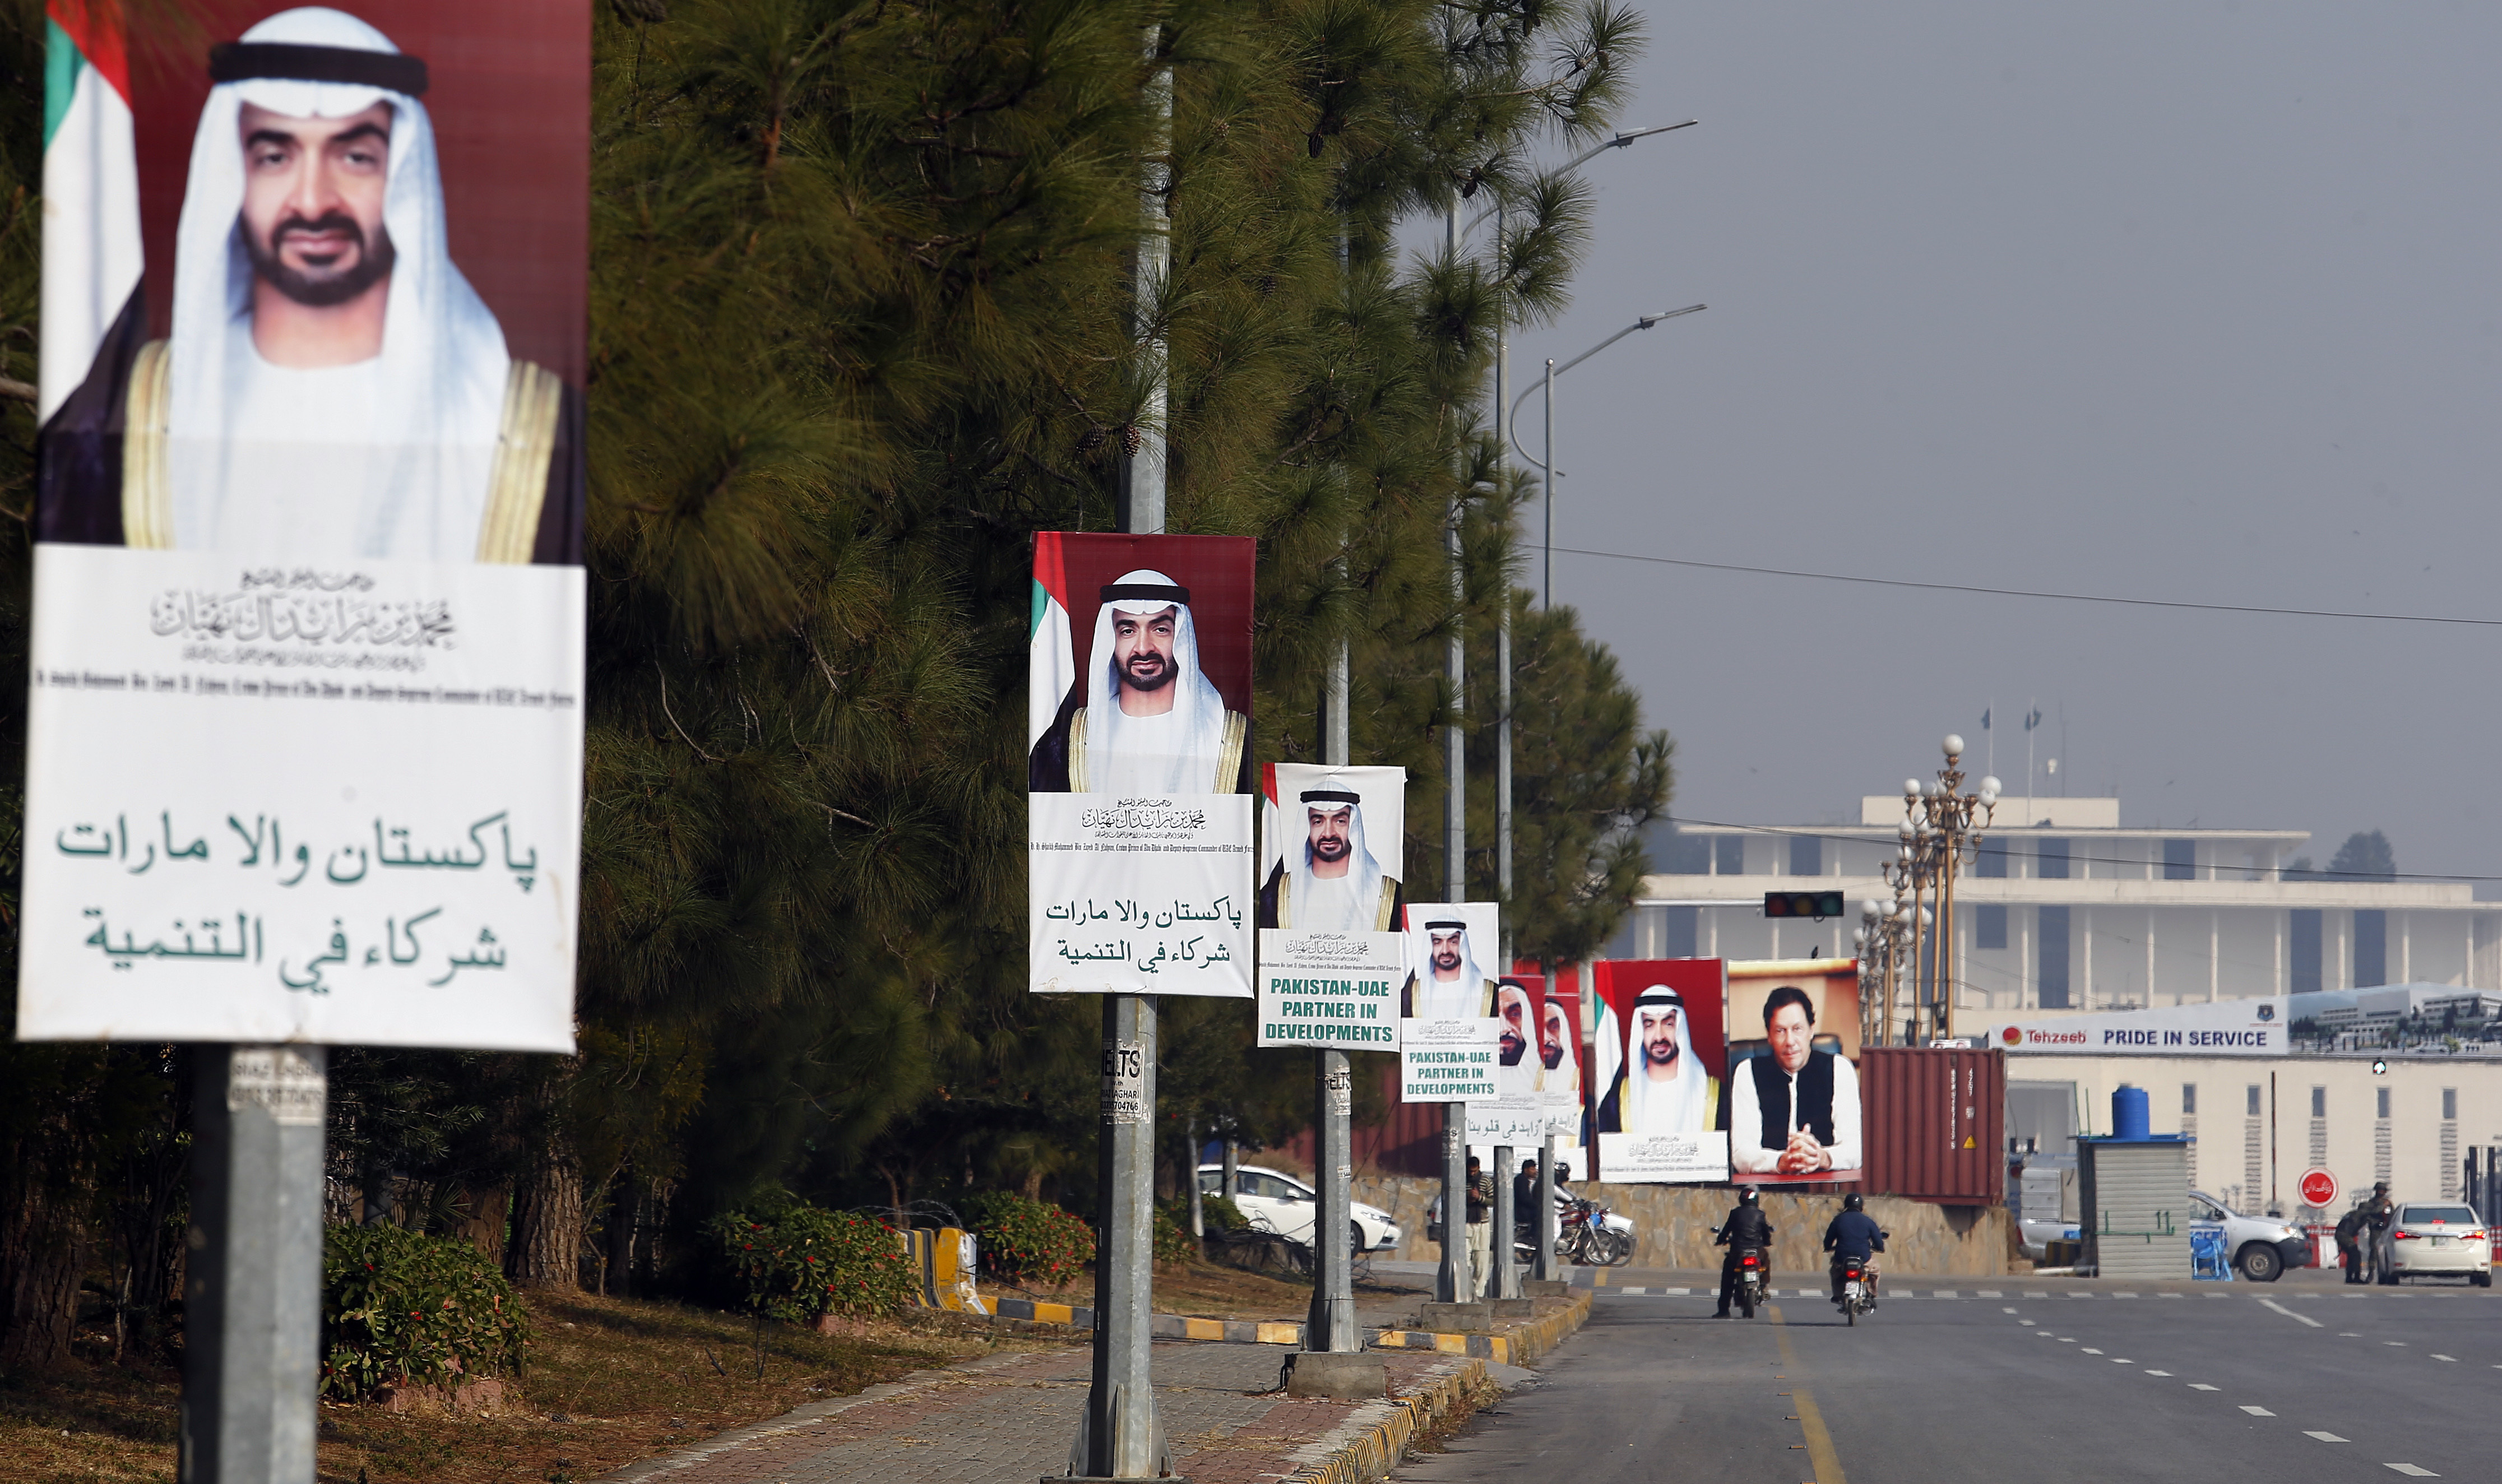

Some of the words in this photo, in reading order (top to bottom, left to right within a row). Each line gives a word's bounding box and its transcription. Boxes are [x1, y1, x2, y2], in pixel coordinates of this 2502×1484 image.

[83, 908, 263, 970] التنمية
[364, 908, 506, 986] شركاء
[280, 917, 349, 994] في
[1057, 938, 1131, 965] التنمية
[1138, 941, 1166, 974] في
[1171, 935, 1230, 970] شركاء
[1270, 978, 1389, 996] PAKISTAN-UAE
[1282, 1001, 1356, 1018] PARTNER
[1360, 1003, 1378, 1018] IN
[1266, 1023, 1393, 1042] DEVELOPMENTS
[2026, 1029, 2087, 1044] Tehzeeb
[2104, 1030, 2157, 1045] PRIDE
[2164, 1031, 2182, 1045] IN
[2189, 1032, 2267, 1046] SERVICE
[1409, 1052, 1491, 1064] PAKISTAN-UAE
[1417, 1068, 1469, 1079] PARTNER
[1472, 1068, 1484, 1079] IN
[1407, 1083, 1495, 1095] DEVELOPMENTS
